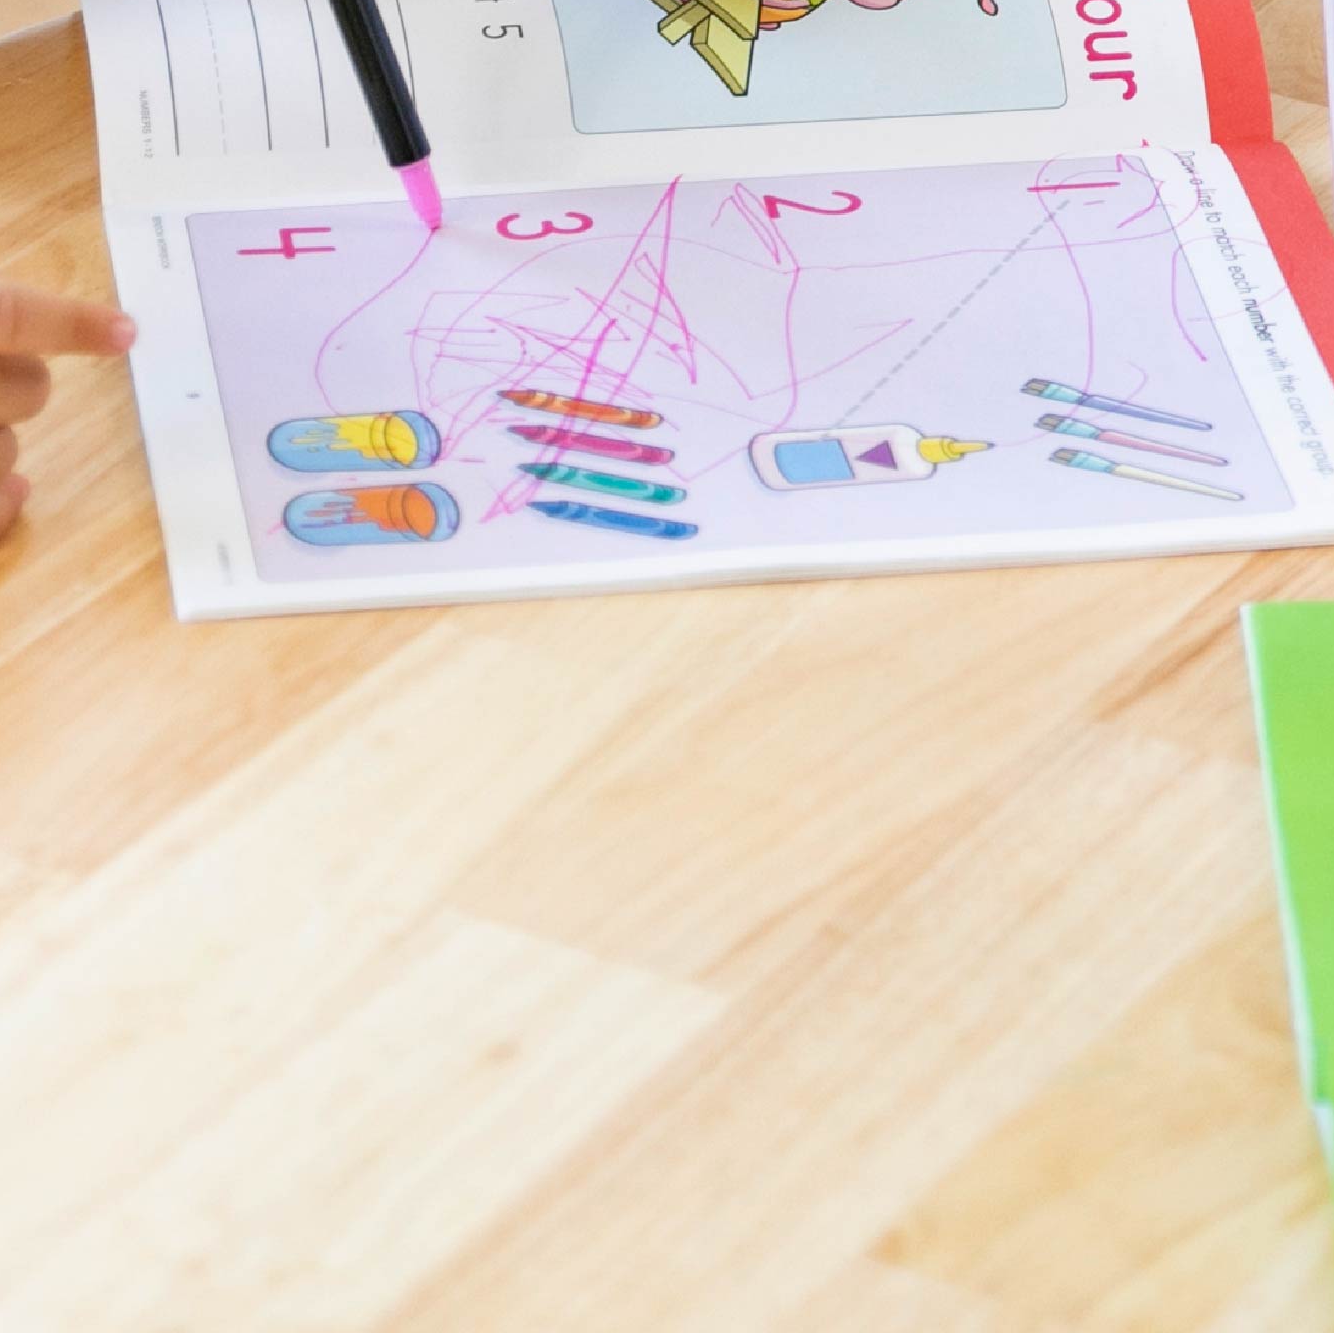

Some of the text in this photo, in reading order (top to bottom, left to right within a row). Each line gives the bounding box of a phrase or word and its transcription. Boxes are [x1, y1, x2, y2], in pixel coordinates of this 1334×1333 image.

[481, 24, 524, 39] 5
[1171, 149, 1196, 175] Draw
[1189, 177, 1203, 186] a
[764, 190, 862, 221] 2
[1194, 188, 1217, 208] line
[496, 211, 594, 243] 3
[1204, 211, 1223, 223] to
[237, 226, 335, 260] 4
[1213, 226, 1246, 262] match
[1228, 265, 1260, 295] each
[1241, 298, 1278, 344] number
[1264, 347, 1290, 373] with
[1278, 374, 1301, 394] the
[1287, 396, 1320, 436] correct
